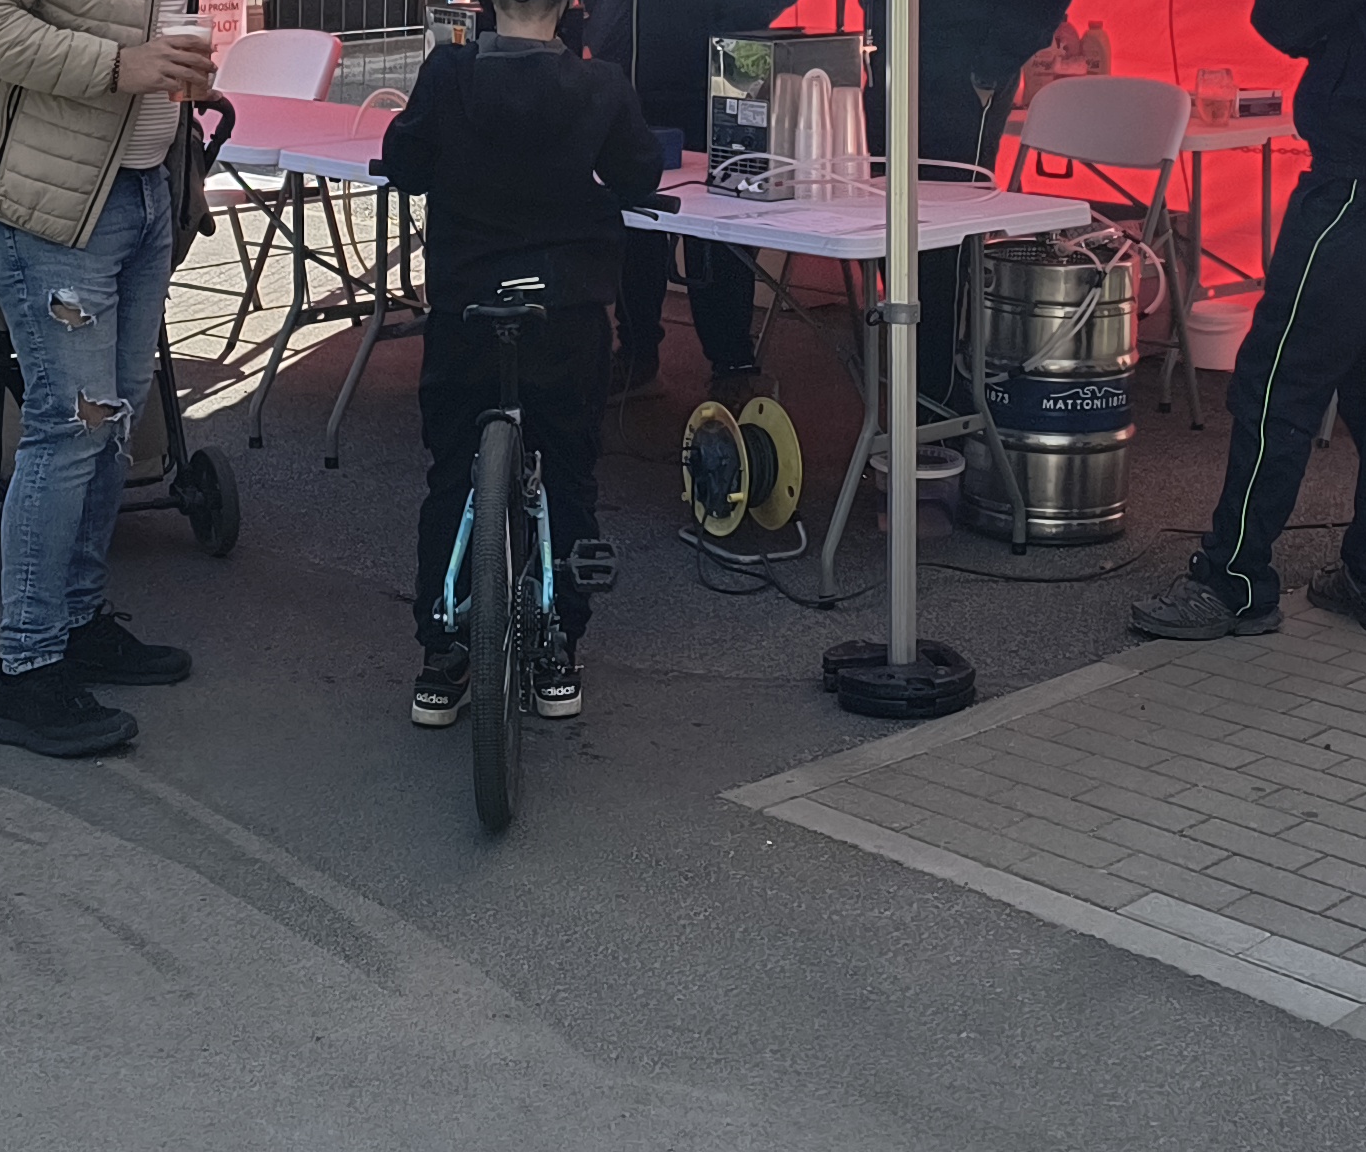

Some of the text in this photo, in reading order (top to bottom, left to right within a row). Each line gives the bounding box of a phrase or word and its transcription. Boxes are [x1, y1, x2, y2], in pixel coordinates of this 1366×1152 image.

[208, 1, 239, 12] PROSÍM
[986, 388, 1010, 404] 1873
[1042, 394, 1127, 410] MATTONI 1873
[541, 685, 576, 696] adidas
[416, 692, 448, 704] adidas
